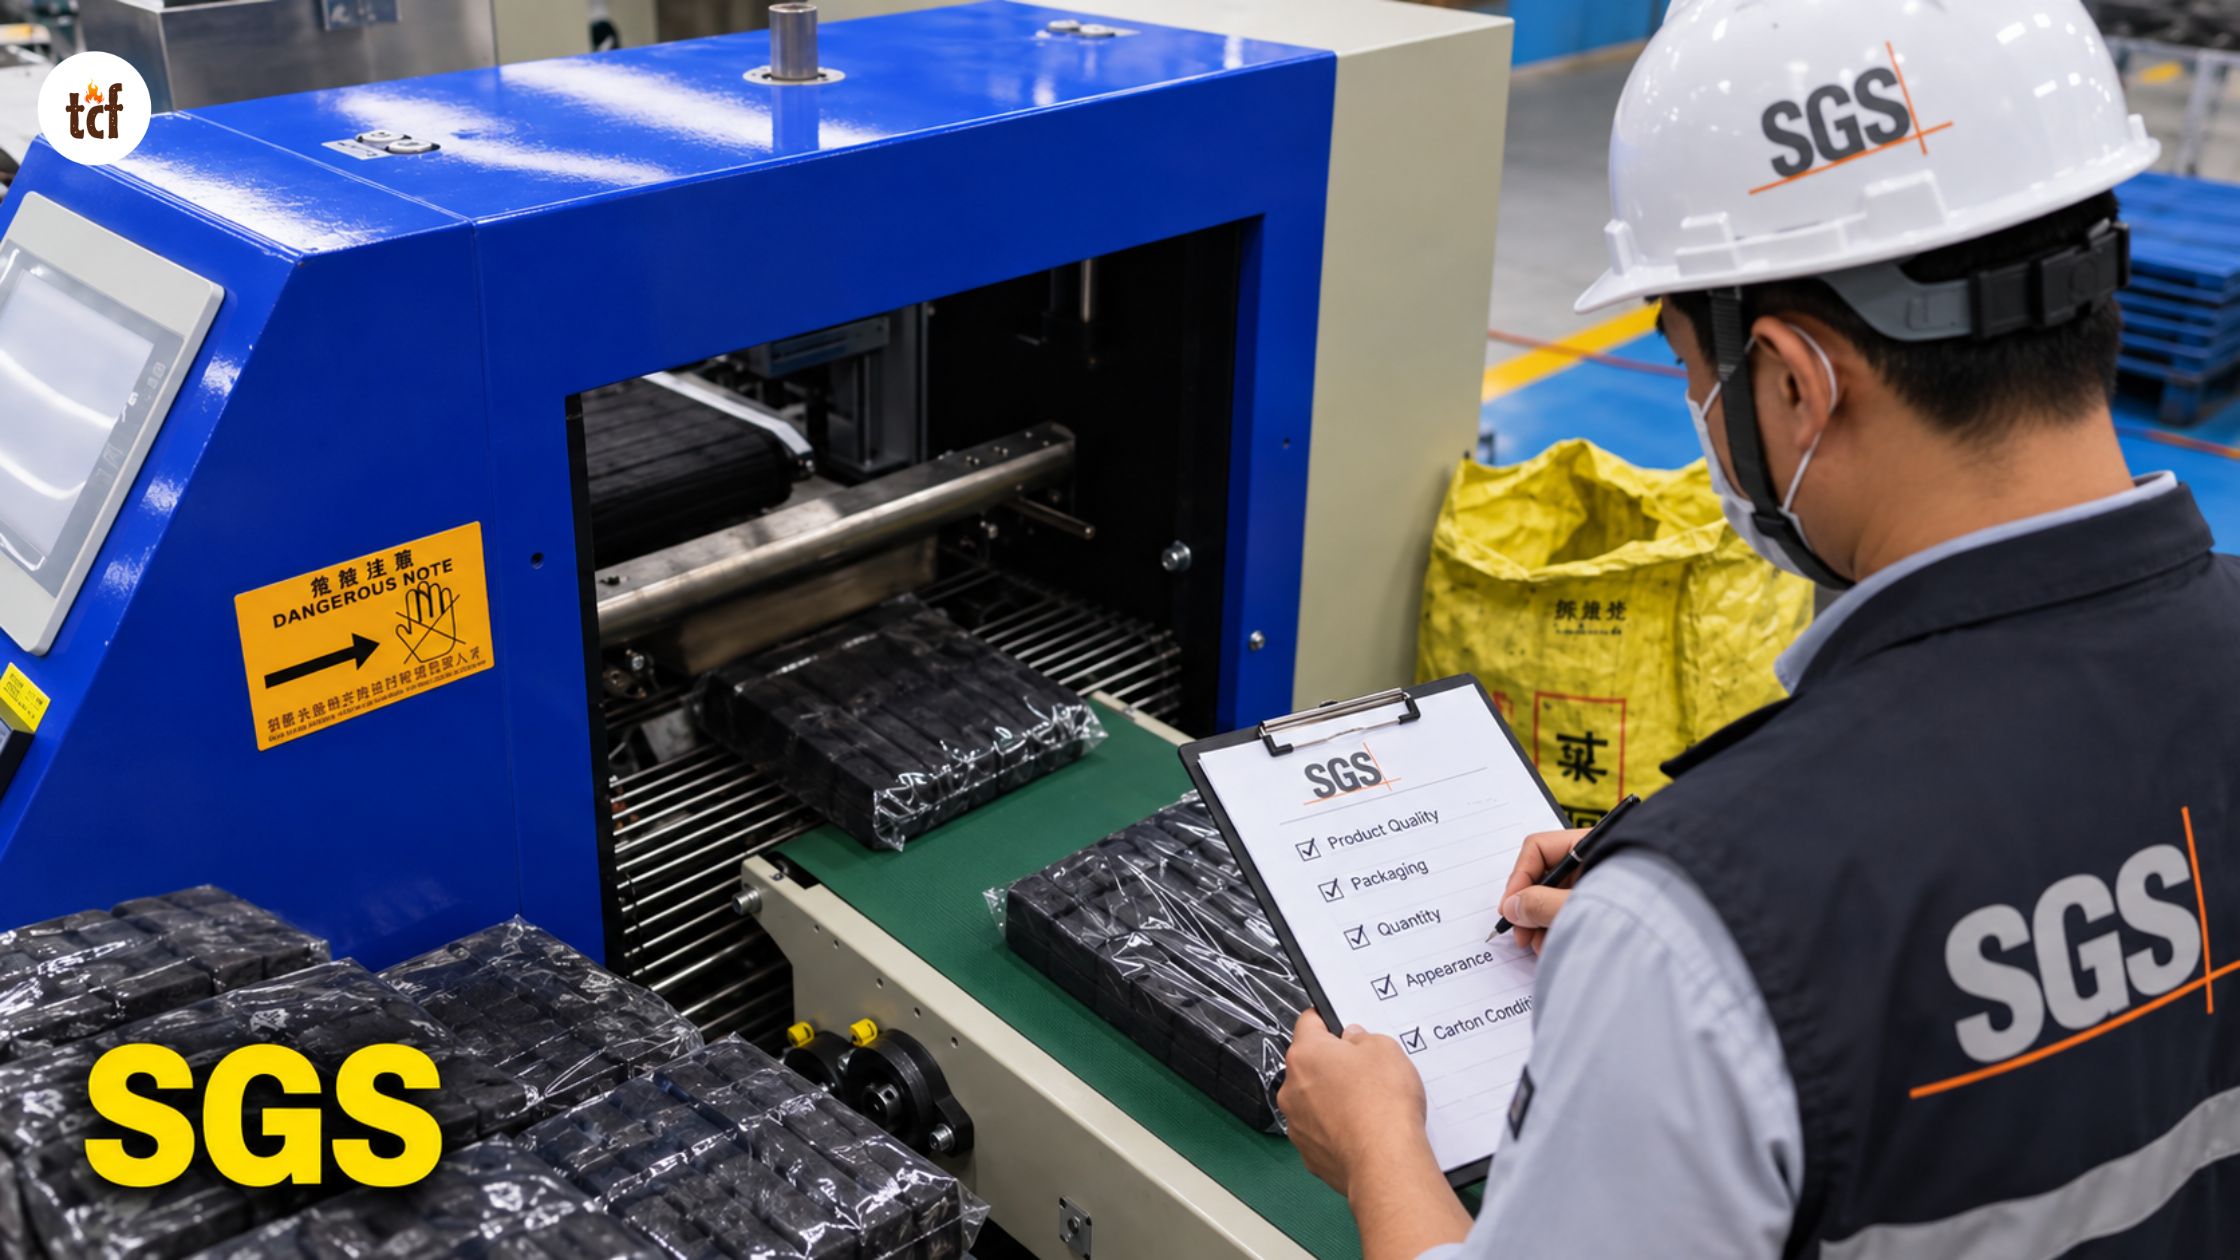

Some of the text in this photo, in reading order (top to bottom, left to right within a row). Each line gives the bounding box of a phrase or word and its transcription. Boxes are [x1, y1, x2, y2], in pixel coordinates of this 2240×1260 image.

[1762, 68, 1910, 177] SGS
[272, 577, 396, 629] DANGEROUS
[403, 558, 453, 586] NOTE
[1304, 752, 1382, 798] SGS
[1327, 810, 1439, 849] Product Quality
[1350, 860, 1429, 890] Packaging
[1377, 909, 1441, 937] Quantity
[1406, 951, 1493, 987] Appearance
[1946, 844, 2201, 1061] SGS
[1433, 1015, 1484, 1040] Carton
